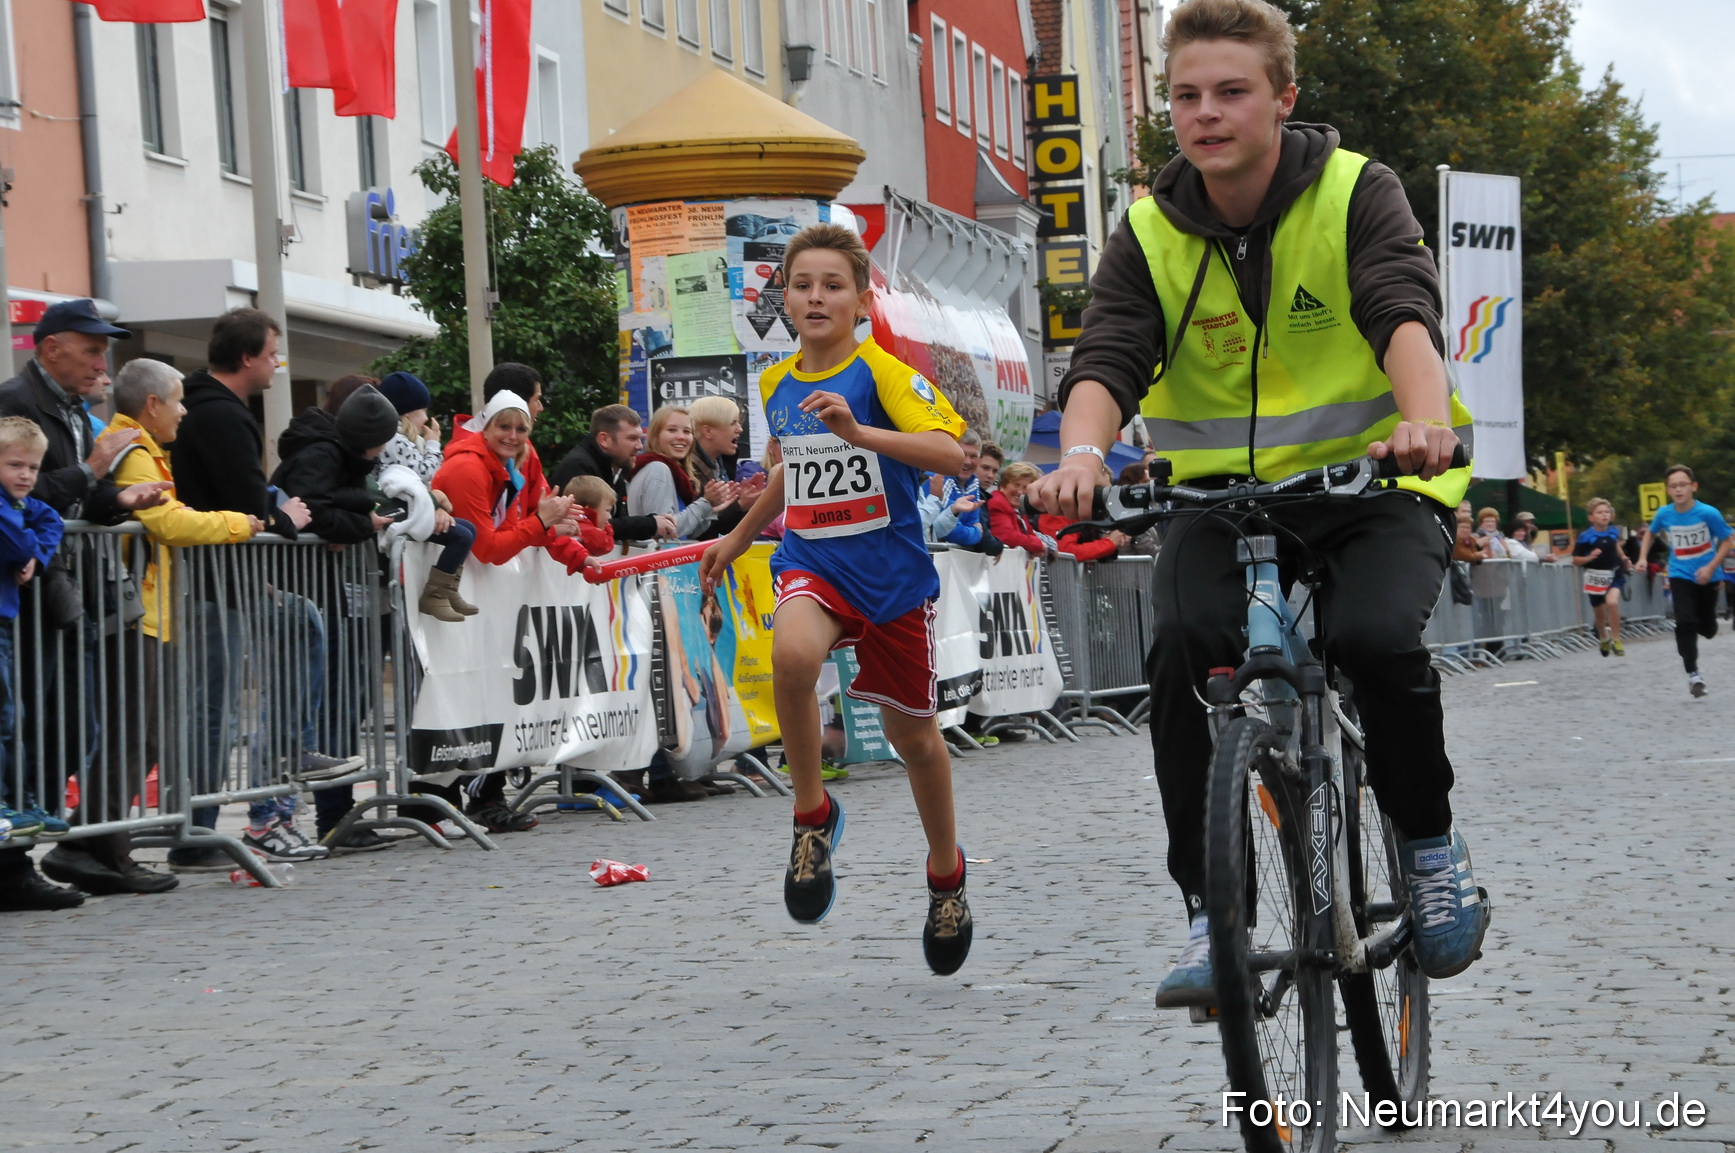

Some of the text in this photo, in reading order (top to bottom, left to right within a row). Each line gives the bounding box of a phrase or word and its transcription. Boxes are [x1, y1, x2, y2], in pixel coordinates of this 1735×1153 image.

[637, 204, 682, 214] NEUMARKTER
[688, 206, 699, 214] 38.
[1034, 81, 1084, 339] HOTEL
[629, 212, 683, 224] FRÜHLINGSFEST
[1192, 311, 1237, 327] NEUMARKTER
[1202, 317, 1239, 331] STADTLAUF
[660, 378, 737, 399] GLENN
[788, 454, 872, 500] 7223
[810, 508, 852, 526] Jonas
[1675, 530, 1706, 547] 7127
[647, 554, 697, 571] Audi BKK
[572, 702, 640, 743] neumarkt
[1309, 788, 1329, 902] AXEL
[1419, 852, 1448, 863] adidas
